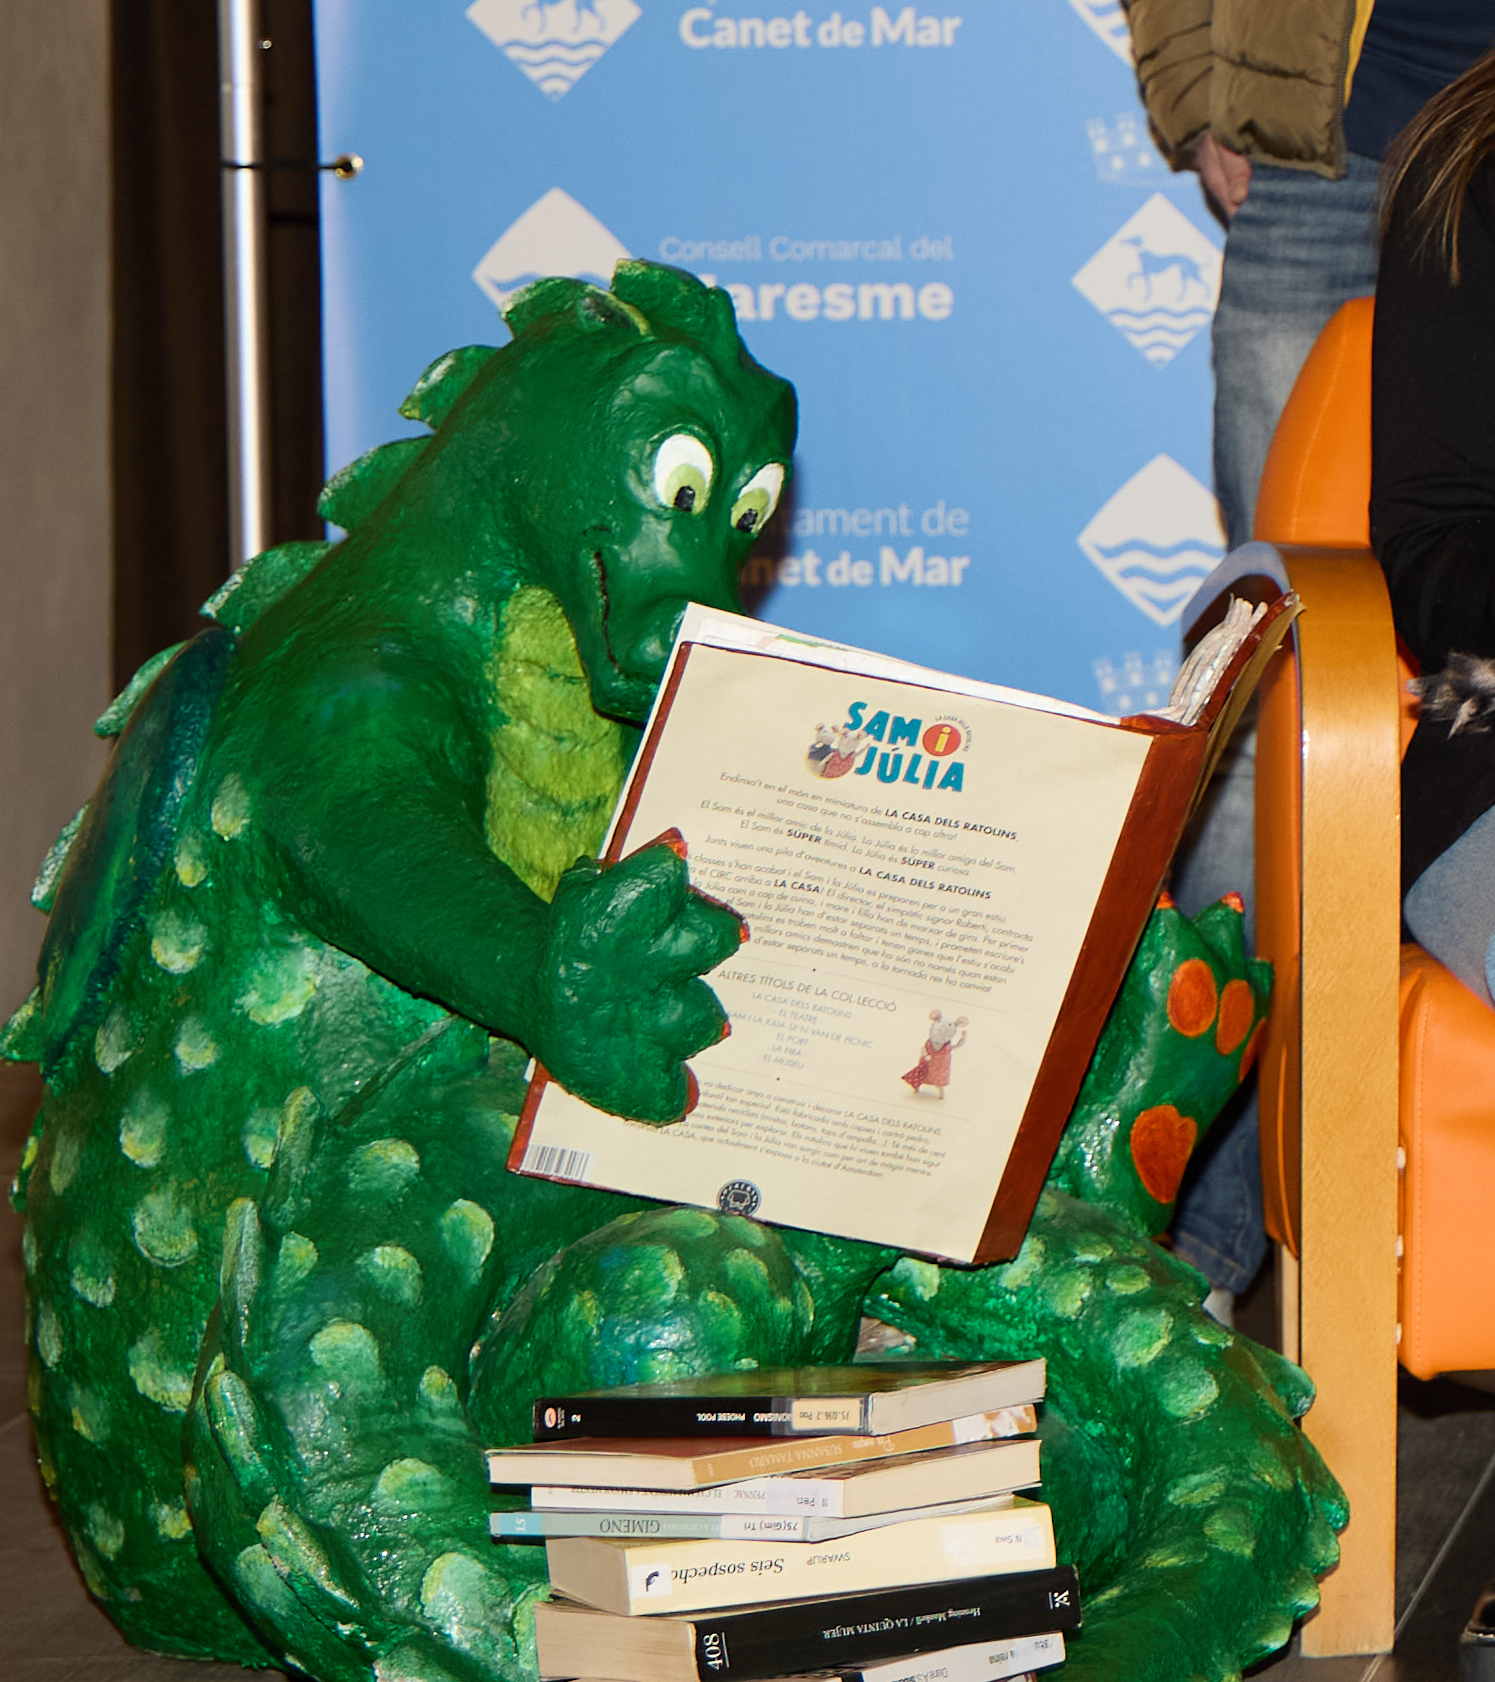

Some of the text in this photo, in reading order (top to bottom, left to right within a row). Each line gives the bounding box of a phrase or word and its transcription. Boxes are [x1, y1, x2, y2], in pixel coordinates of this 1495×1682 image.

[678, 7, 963, 48] Canet de Mar
[659, 235, 954, 262] Consell Comarcal del
[699, 274, 954, 321] aresme
[920, 499, 969, 537] de
[827, 546, 971, 587] de Mar
[843, 701, 922, 747] SAM
[934, 726, 951, 753] i
[854, 746, 965, 792] JÚLIA
[885, 808, 898, 818] LA
[902, 811, 931, 825] CASA
[934, 817, 960, 829] DELS
[774, 879, 786, 888] LA
[859, 867, 992, 899] LA CASA DELS RATOLINS
[717, 969, 755, 984] ALTRES
[759, 973, 795, 991] TÍTOLS
[797, 982, 813, 994] DE
[815, 986, 828, 997] LA
[748, 1442, 844, 1469] SUSANNA TAMARO
[732, 1490, 766, 1499] PENNAC
[600, 1519, 661, 1533] GIMENO
[751, 1557, 785, 1574] Seis
[806, 1551, 851, 1566] SWARUP
[822, 1624, 856, 1640] MUJER
[857, 1619, 893, 1633] QUINTA
[894, 1616, 910, 1628] LA
[703, 1632, 724, 1671] 408
